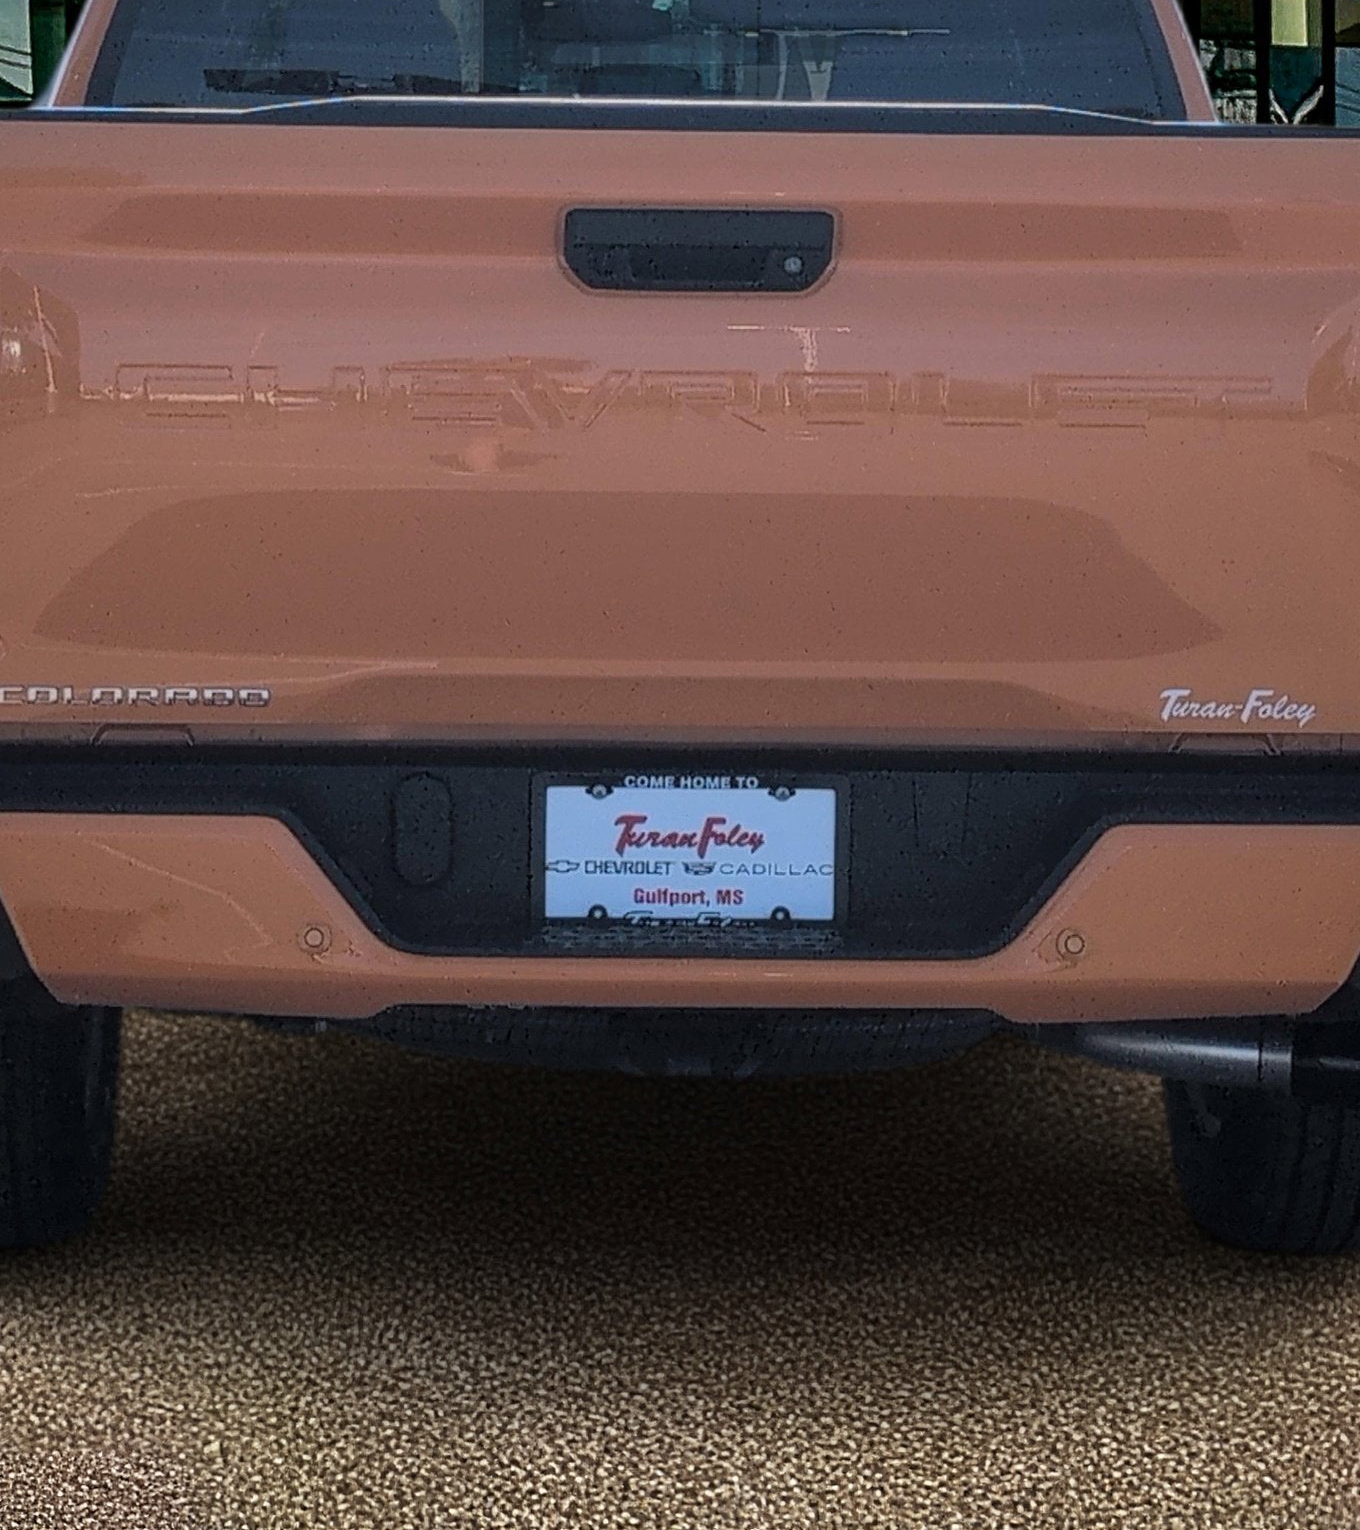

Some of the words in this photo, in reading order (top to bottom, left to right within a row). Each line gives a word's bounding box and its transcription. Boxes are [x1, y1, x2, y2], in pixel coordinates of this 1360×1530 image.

[623, 774, 675, 788] COME
[680, 775, 731, 789] HOME
[736, 776, 760, 789] TO
[584, 860, 672, 876] CHEVROLET
[719, 863, 834, 876] CADILLAC
[633, 888, 710, 906] Gulfport,
[716, 889, 744, 905] MS
